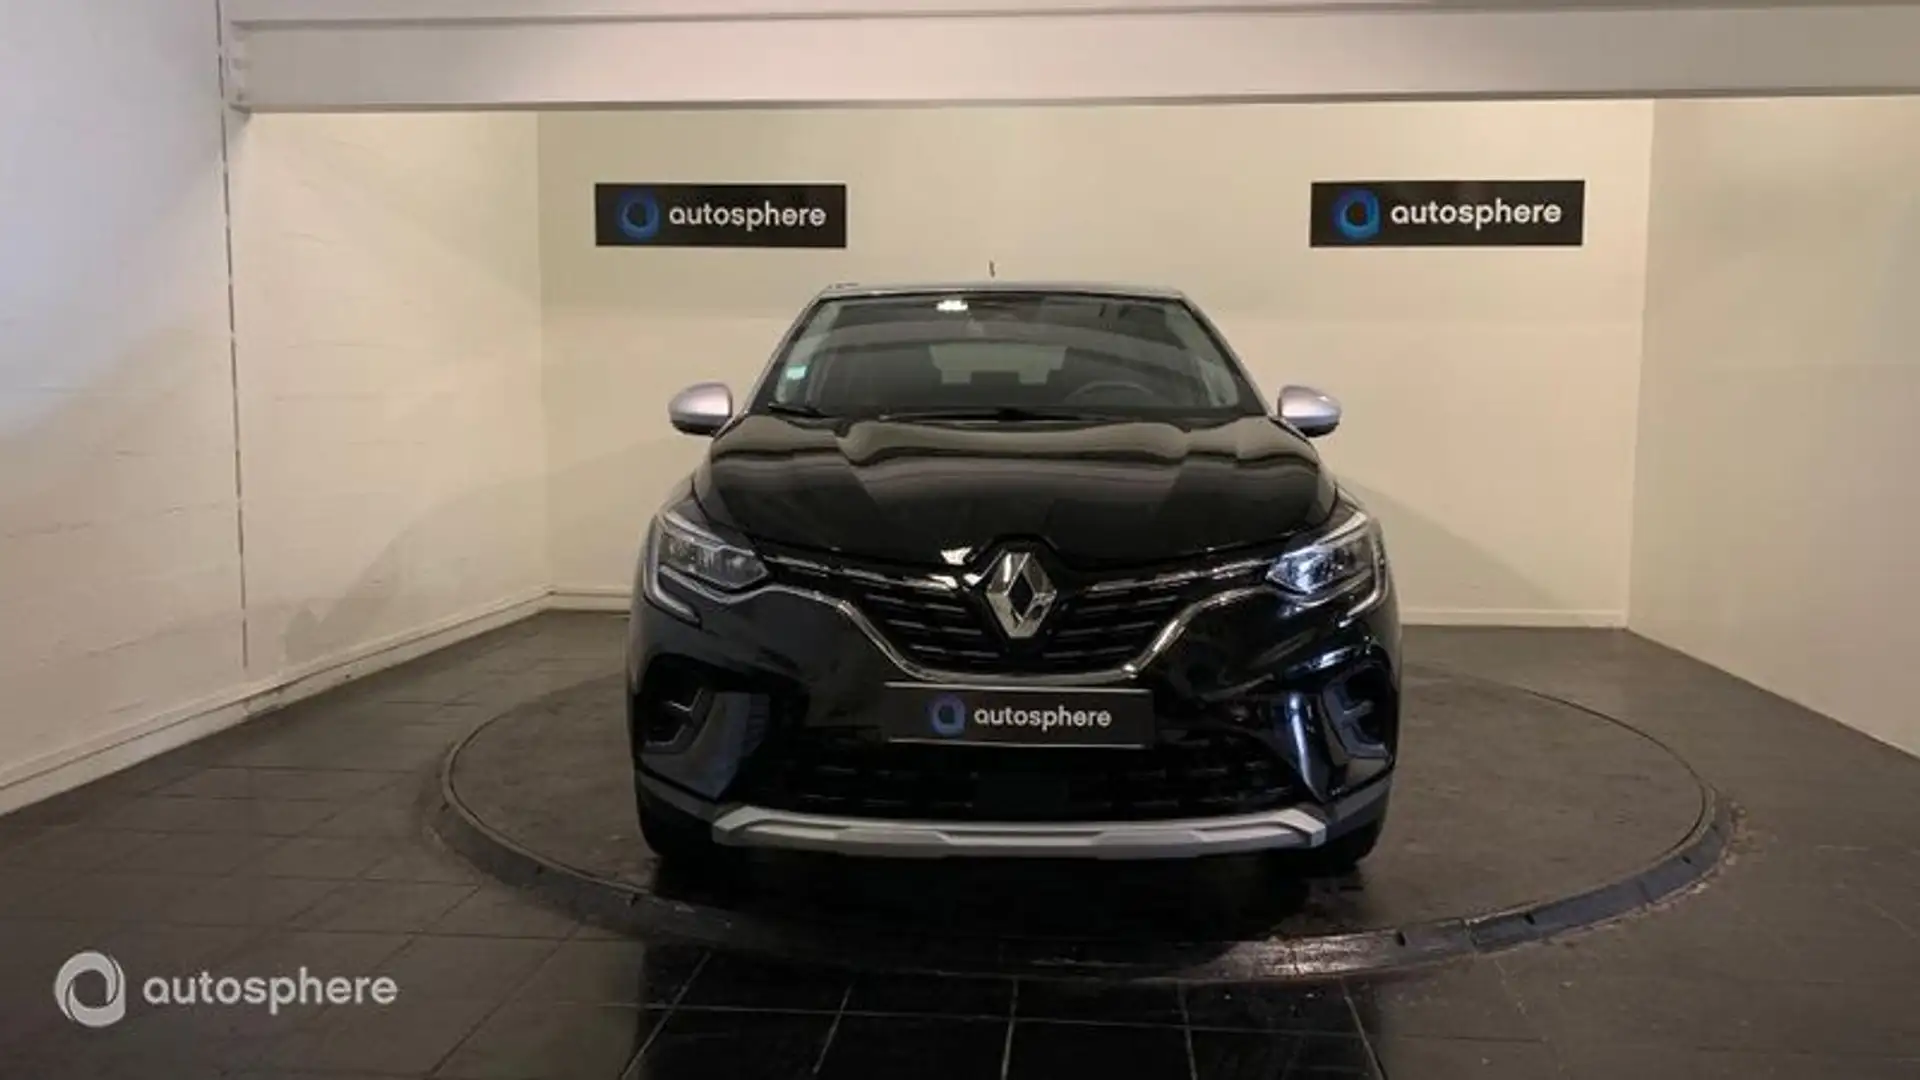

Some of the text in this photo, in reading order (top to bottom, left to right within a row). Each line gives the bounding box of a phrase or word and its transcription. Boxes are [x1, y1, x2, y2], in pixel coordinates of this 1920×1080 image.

[669, 201, 827, 232] autosphere
[1390, 197, 1562, 231] autosphere
[974, 704, 1112, 732] autosphere
